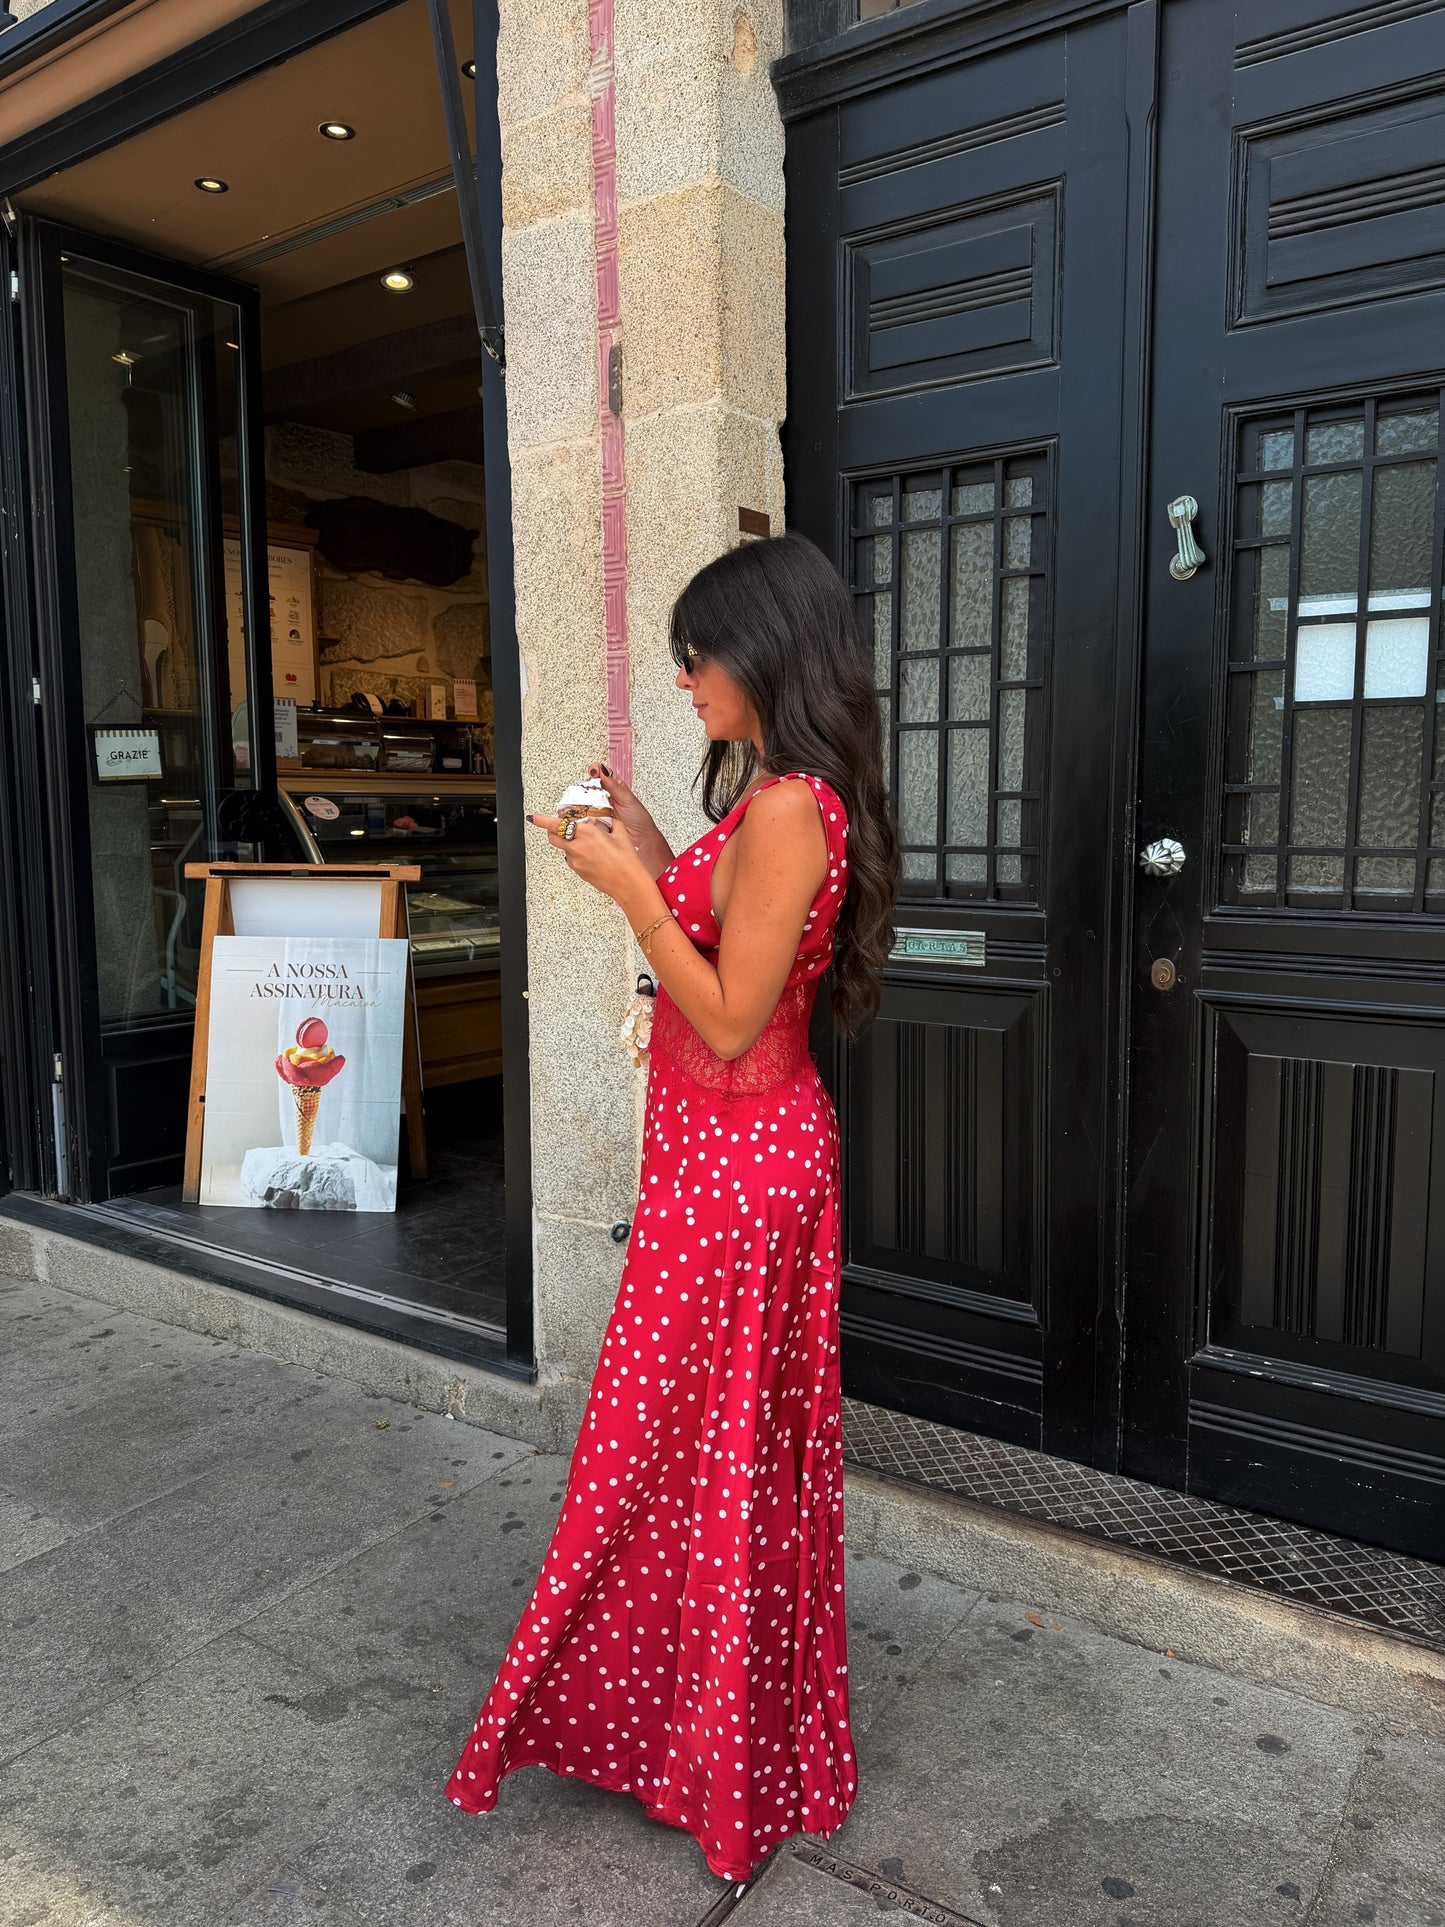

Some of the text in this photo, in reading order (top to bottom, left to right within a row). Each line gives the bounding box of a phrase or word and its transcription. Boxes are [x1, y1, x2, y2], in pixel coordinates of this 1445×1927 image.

[110, 750, 149, 760] GRAZIE
[908, 940, 966, 953] CARTAS
[267, 963, 349, 979] A NOSSA
[250, 982, 364, 1000] ASSINATURA
[869, 1883, 946, 1923] PORTO
